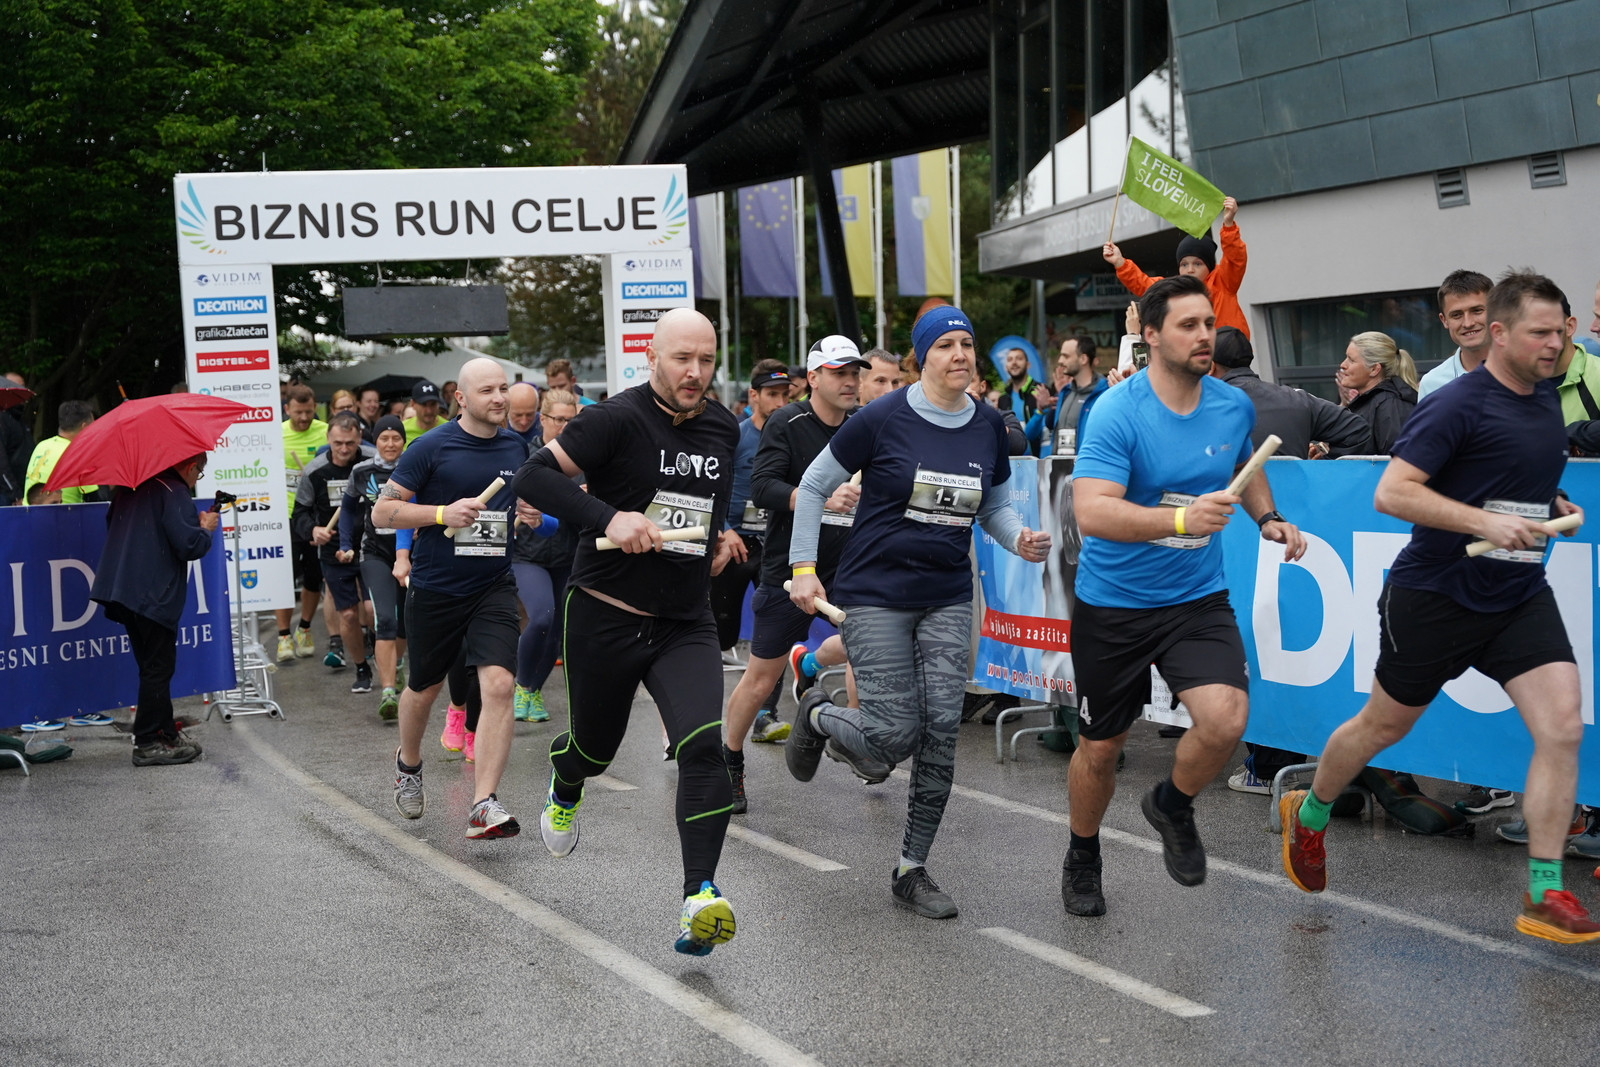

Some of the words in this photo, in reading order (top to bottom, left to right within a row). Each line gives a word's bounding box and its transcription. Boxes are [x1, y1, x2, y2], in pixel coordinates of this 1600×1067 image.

[1141, 151, 1151, 167] I
[1151, 157, 1185, 187] FEEL
[1135, 168, 1206, 218] SLOVENIA
[213, 201, 379, 241] BIZNIS
[397, 198, 495, 238] RUN
[511, 196, 659, 235] CELJE
[639, 259, 683, 268] VIDIM
[212, 272, 262, 282] VIDIM
[624, 284, 684, 297] DECATHLON
[197, 298, 264, 313] DECATHLON
[623, 309, 667, 323] grafikaZla
[196, 326, 267, 340] grafikaZlatečan
[624, 340, 653, 348] BIOST
[198, 356, 253, 367] BIOSTEEL
[213, 383, 272, 393] HABECO
[238, 409, 272, 421] ALCO
[215, 434, 272, 448] RIMOBIL
[214, 463, 269, 481] simbio
[921, 474, 943, 483] BIZNIS
[943, 477, 957, 485] RUN
[957, 479, 977, 487] CELJE
[655, 494, 677, 503] BIZNIS
[677, 498, 691, 506] RUN
[692, 500, 708, 509] CELJE
[935, 488, 960, 506] 1-1
[659, 507, 702, 529] 20-1
[471, 522, 498, 538] 2-5
[1026, 627, 1068, 644] zaščita
[60, 634, 131, 662] CENTE
[987, 662, 1074, 694] www.pocinkova
[1080, 696, 1092, 725] 4
